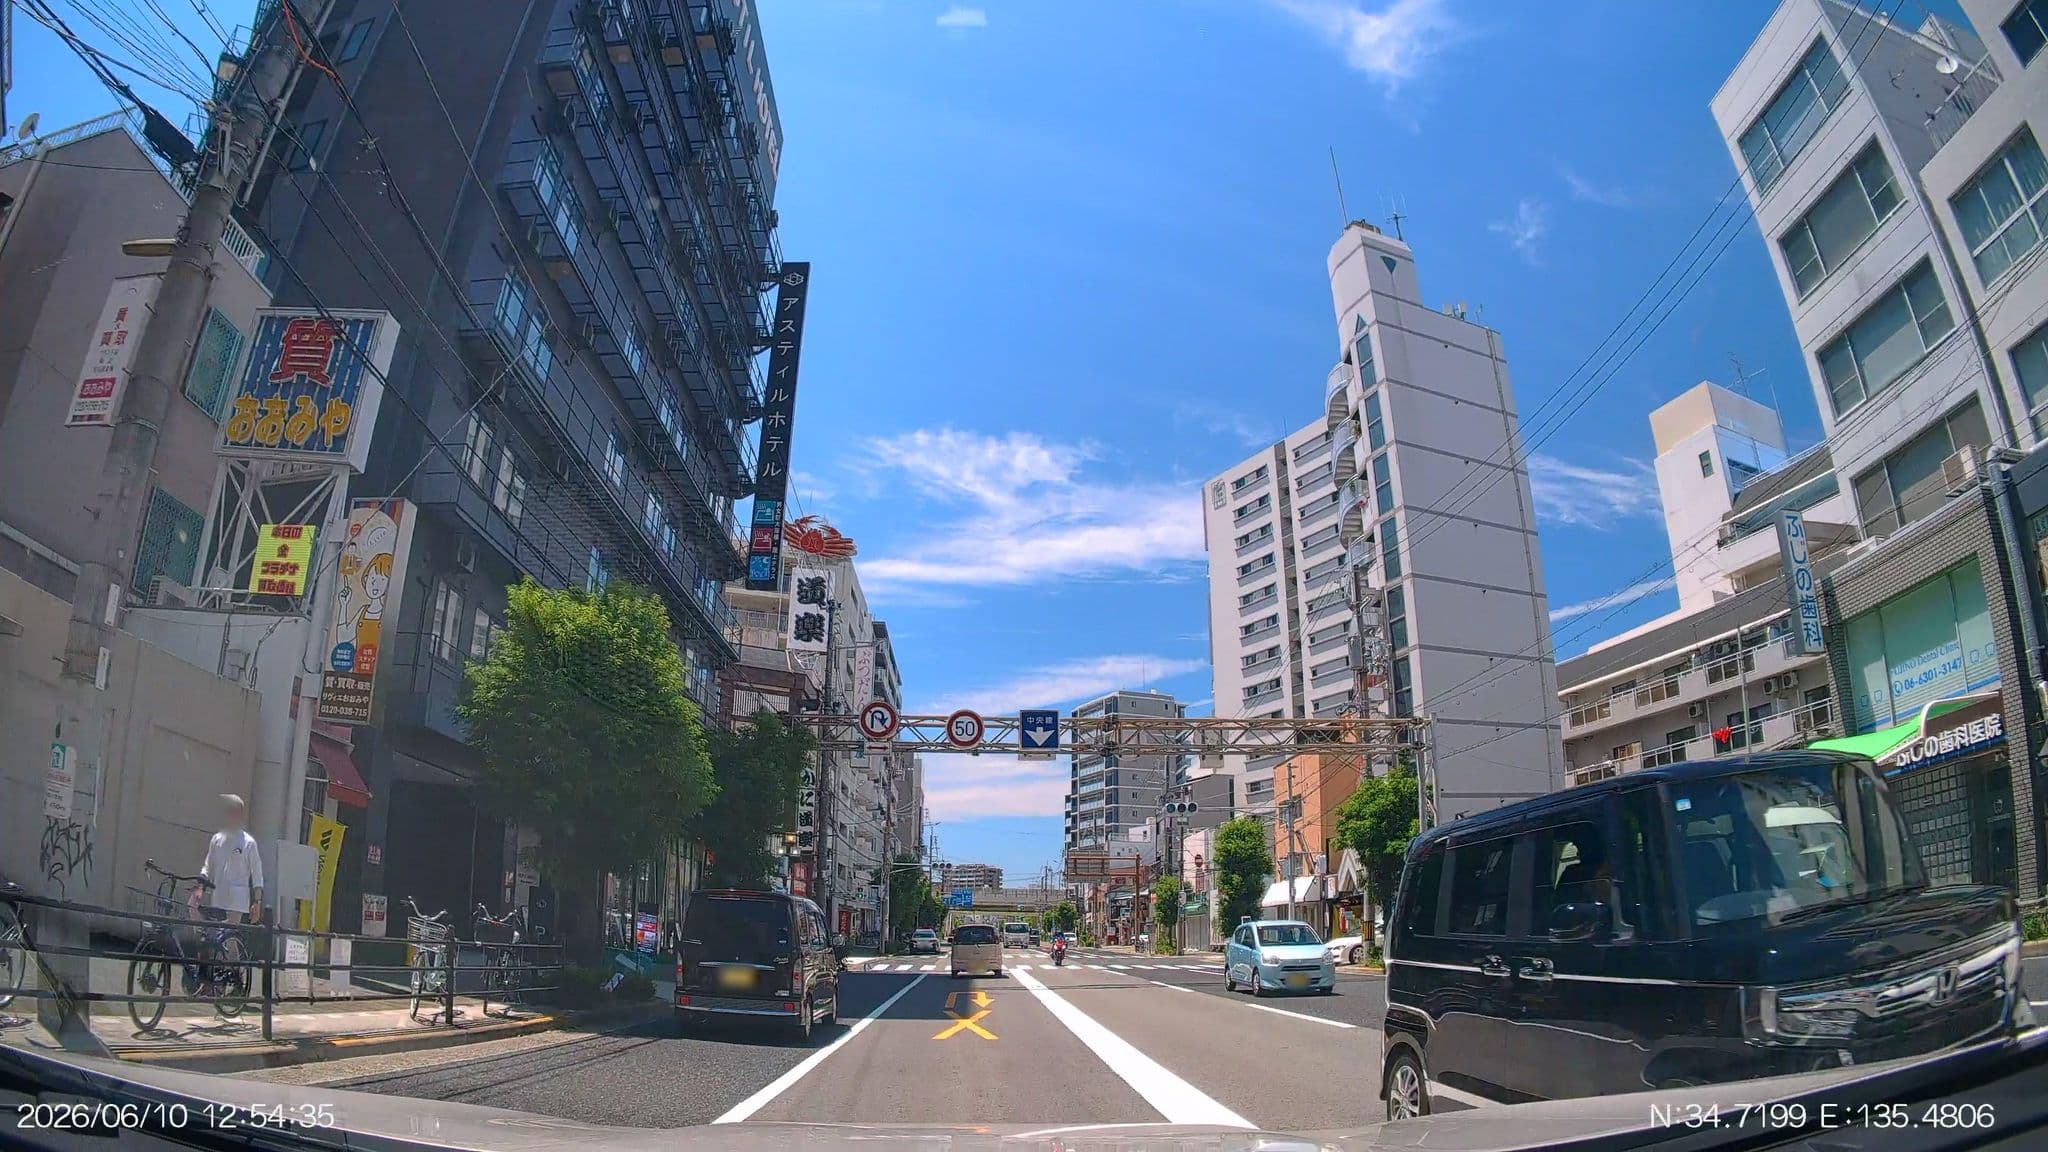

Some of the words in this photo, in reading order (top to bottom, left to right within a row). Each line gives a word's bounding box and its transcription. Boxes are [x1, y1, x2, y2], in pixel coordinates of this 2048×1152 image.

[268, 318, 345, 388] 質
[762, 296, 799, 478] アスティルホテル
[226, 392, 352, 448] おおみや
[1785, 515, 1823, 647] ふじの歯科
[1904, 657, 1962, 690] 06-6301-3147
[955, 720, 975, 737] 50
[1026, 715, 1054, 725] 中央線
